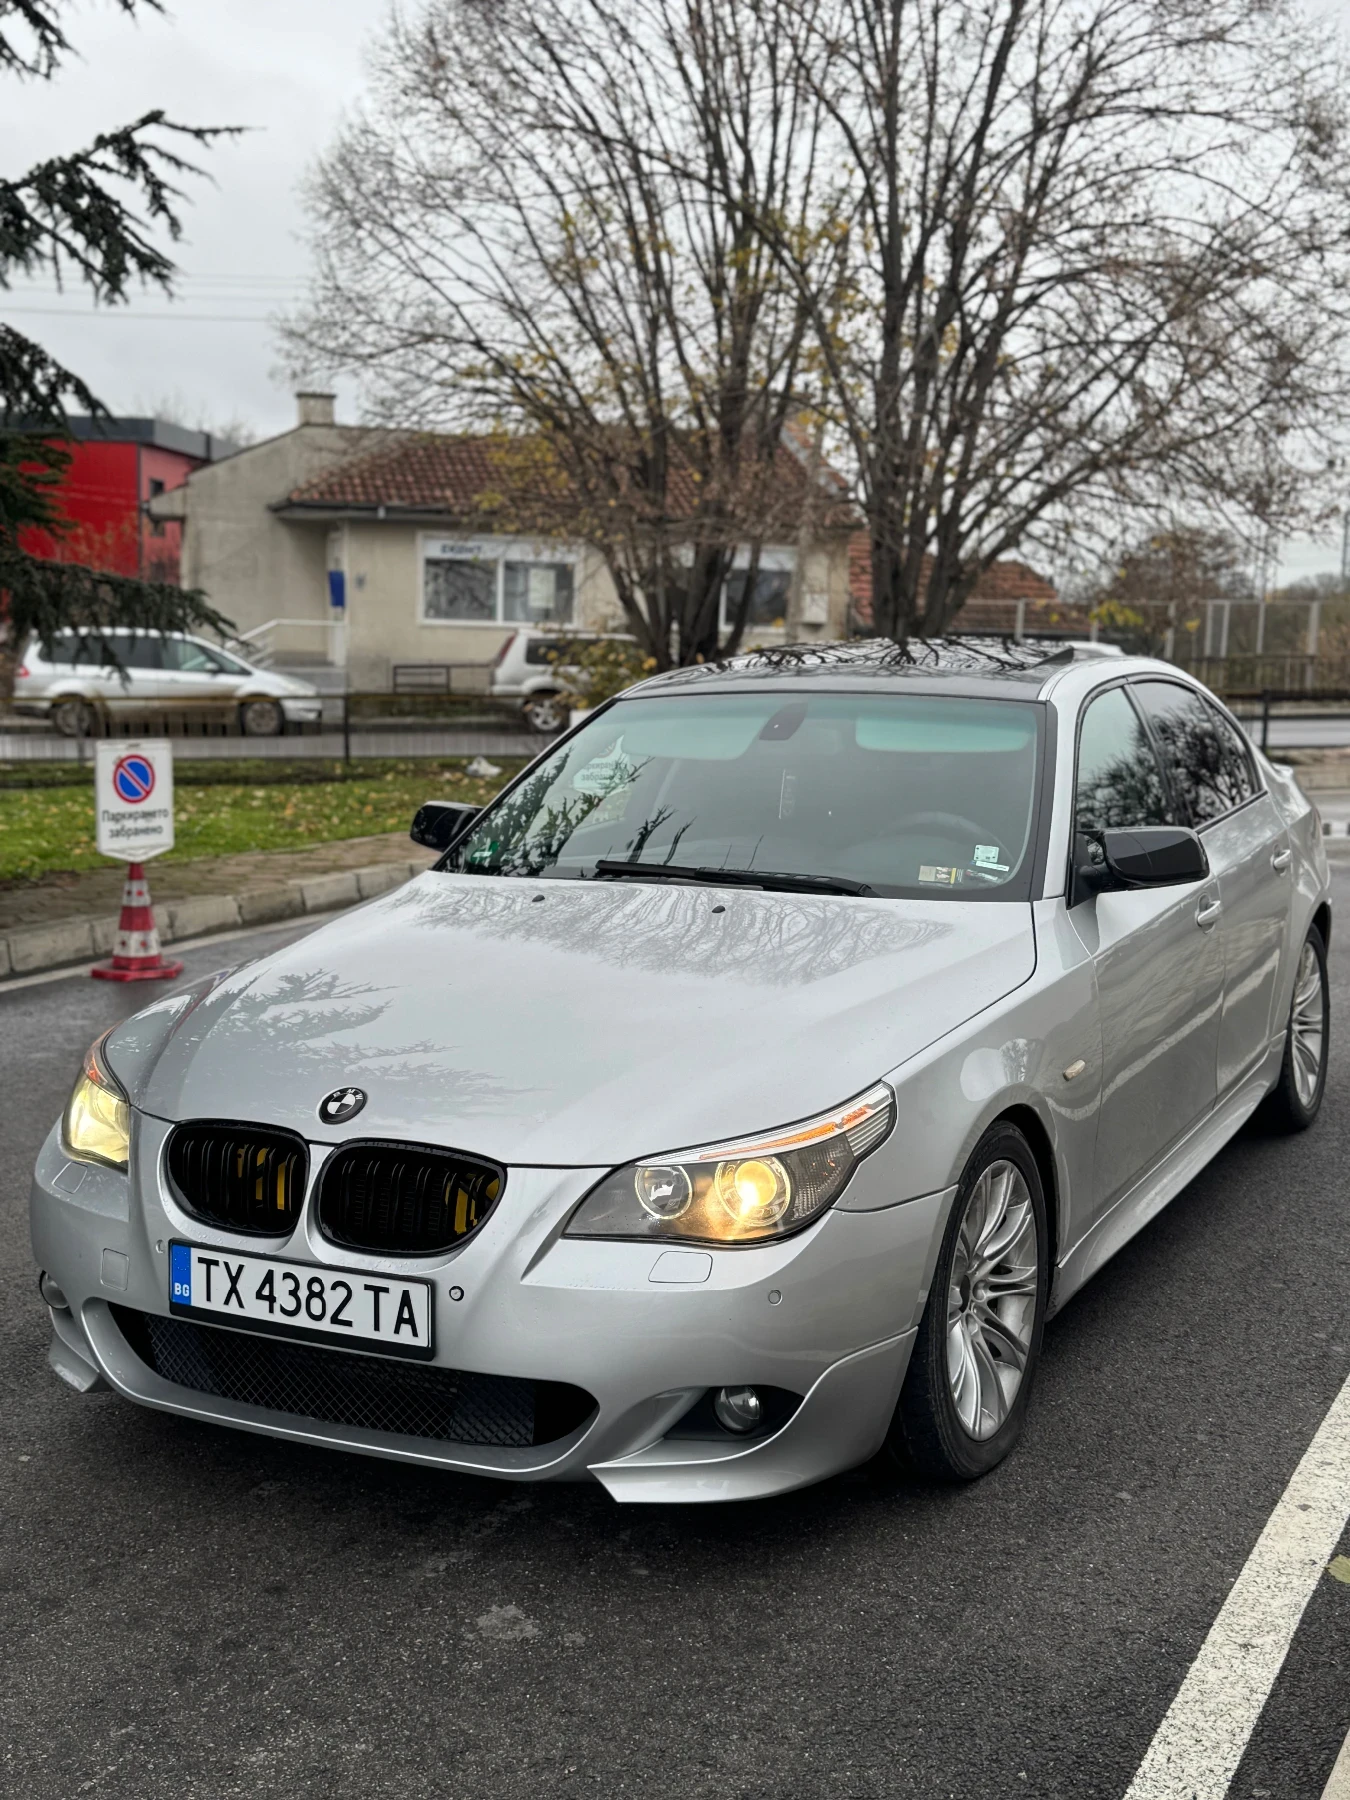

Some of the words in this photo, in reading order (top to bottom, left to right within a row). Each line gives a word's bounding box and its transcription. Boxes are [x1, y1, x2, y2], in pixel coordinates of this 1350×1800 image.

[102, 808, 169, 823] Паркирането
[108, 825, 164, 839] забранено
[332, 1088, 364, 1100] BMW
[174, 1282, 190, 1297] BG
[197, 1256, 245, 1309] TX
[255, 1268, 353, 1328] 4382
[363, 1283, 419, 1338] TA
